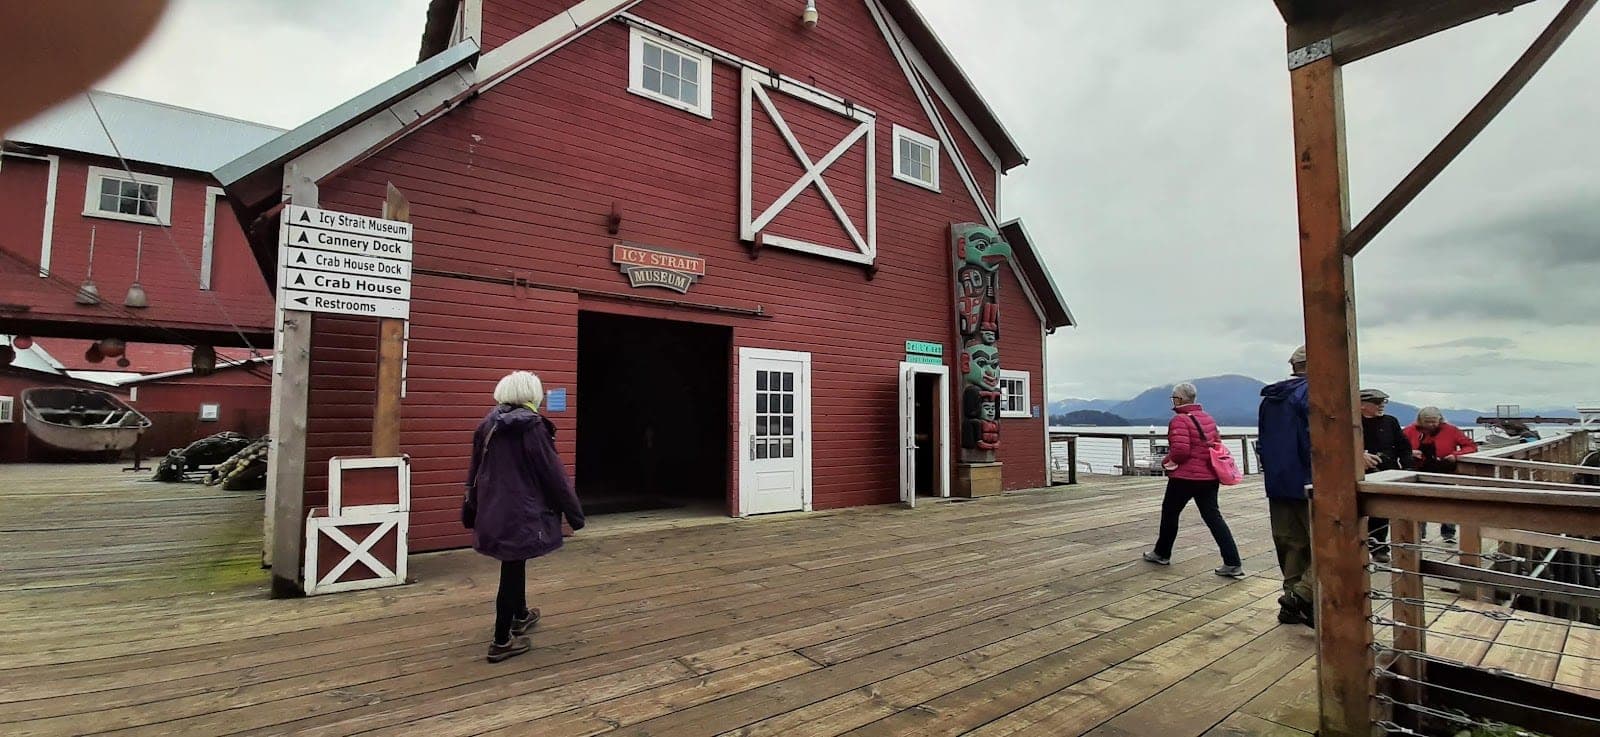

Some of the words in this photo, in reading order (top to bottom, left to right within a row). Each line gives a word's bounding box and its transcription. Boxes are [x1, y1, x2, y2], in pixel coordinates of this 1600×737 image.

[320, 212, 336, 227] Icy
[338, 215, 365, 230] Strait
[369, 220, 407, 235] Museum
[318, 233, 369, 251] Cannery
[374, 241, 401, 253] Dock
[316, 255, 340, 267] Crab
[344, 258, 375, 271] House
[379, 263, 401, 274] Dock
[622, 249, 647, 262] ICY
[651, 254, 698, 270] STRAIT
[315, 276, 350, 289] Crab
[357, 280, 402, 294] House
[634, 271, 685, 287] MUSEUM
[315, 297, 376, 312] Restrooms
